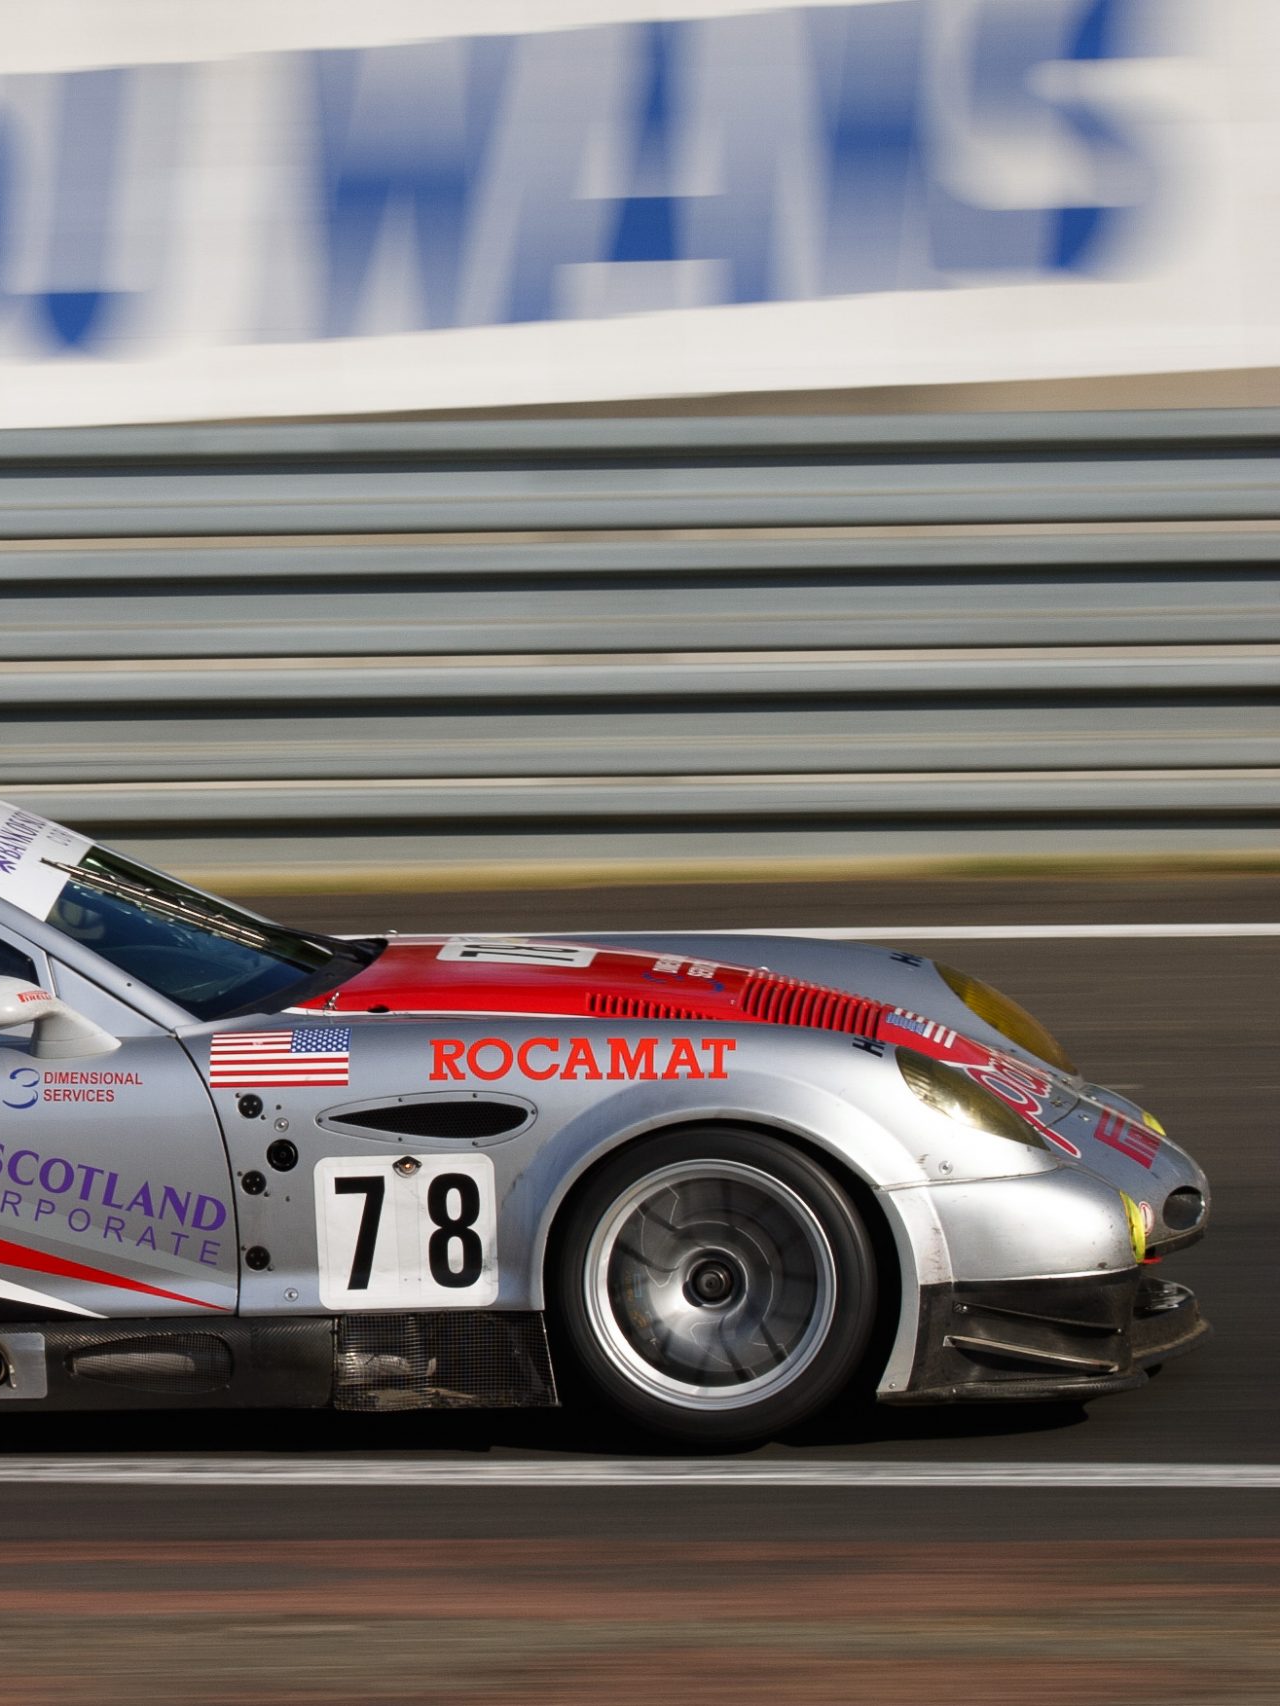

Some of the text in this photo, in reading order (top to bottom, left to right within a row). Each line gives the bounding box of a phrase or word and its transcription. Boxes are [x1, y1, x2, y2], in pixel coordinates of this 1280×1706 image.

[427, 1037, 737, 1081] ROCAMAT
[43, 1071, 144, 1086] DIMENSIONAL
[43, 1088, 116, 1103] SERVICES
[333, 1172, 482, 1291] 78
